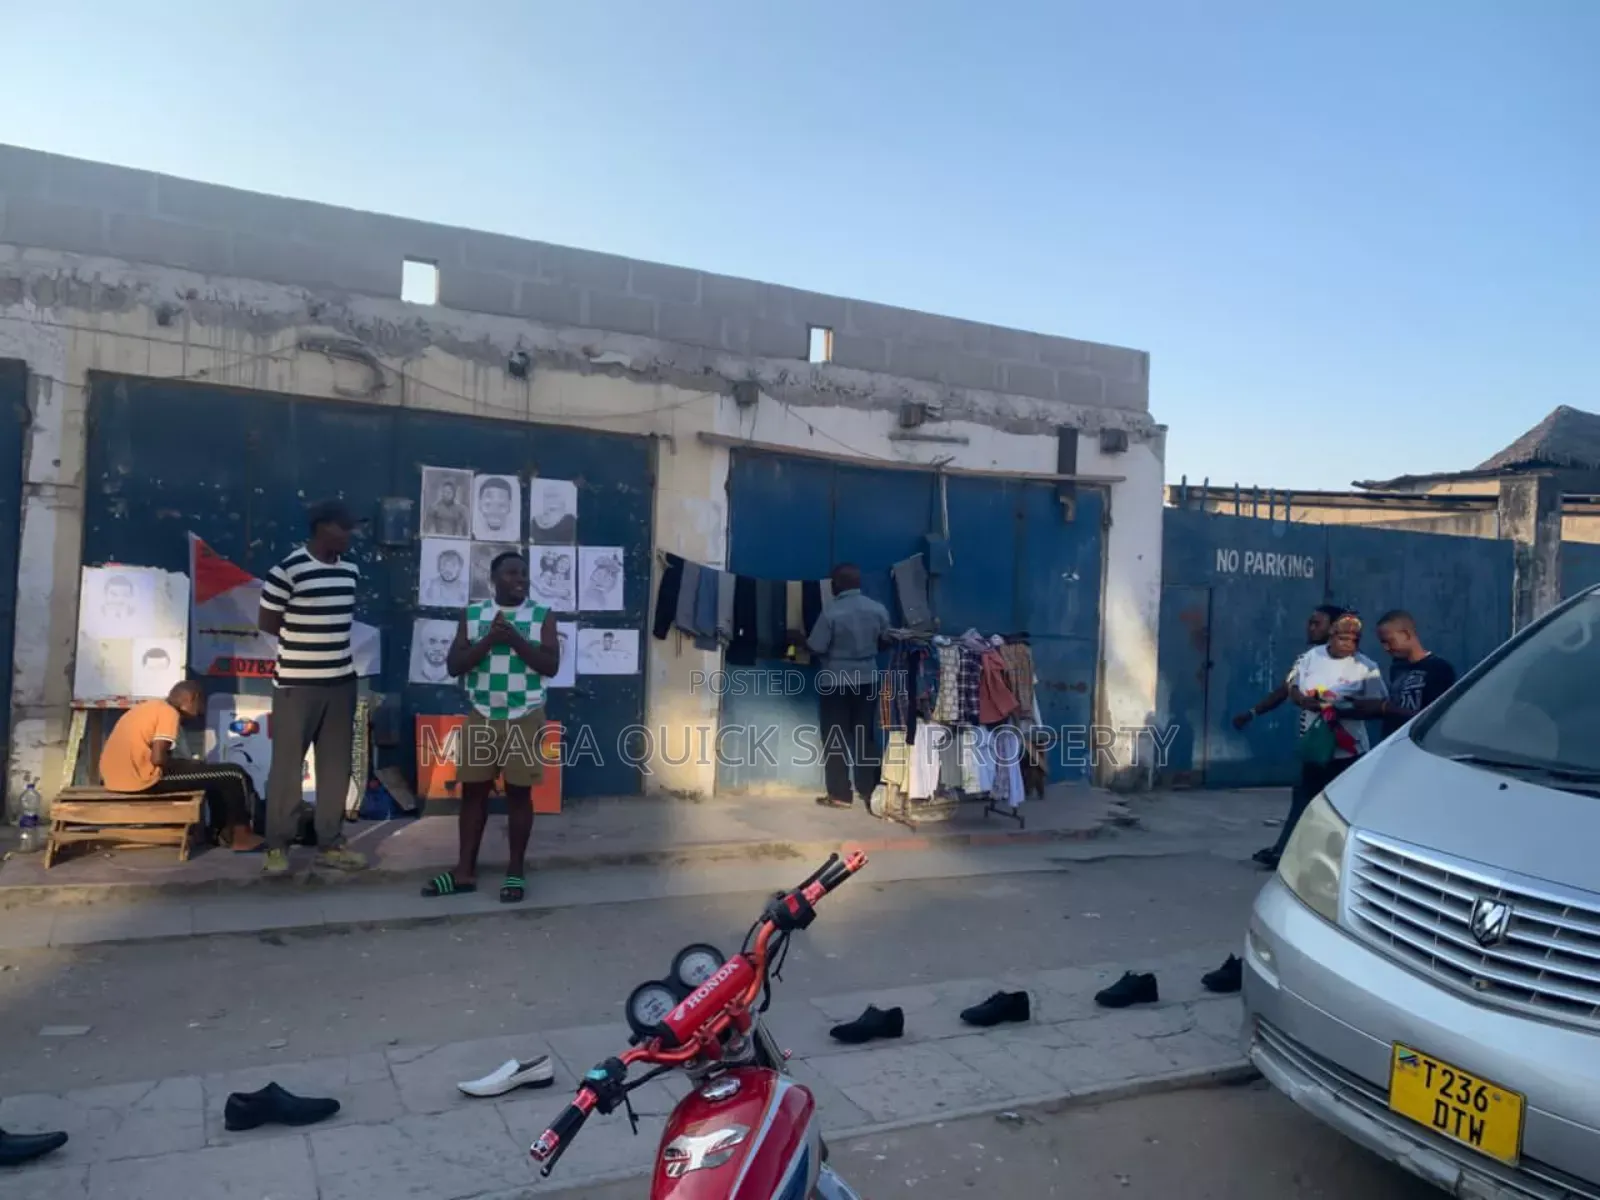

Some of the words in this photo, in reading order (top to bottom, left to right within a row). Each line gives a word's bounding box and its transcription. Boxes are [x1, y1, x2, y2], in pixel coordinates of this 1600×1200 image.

[1216, 548, 1239, 573] NO
[1244, 551, 1314, 578] PARKING
[687, 961, 739, 1009] HONDA
[1432, 1098, 1485, 1146] DTW
